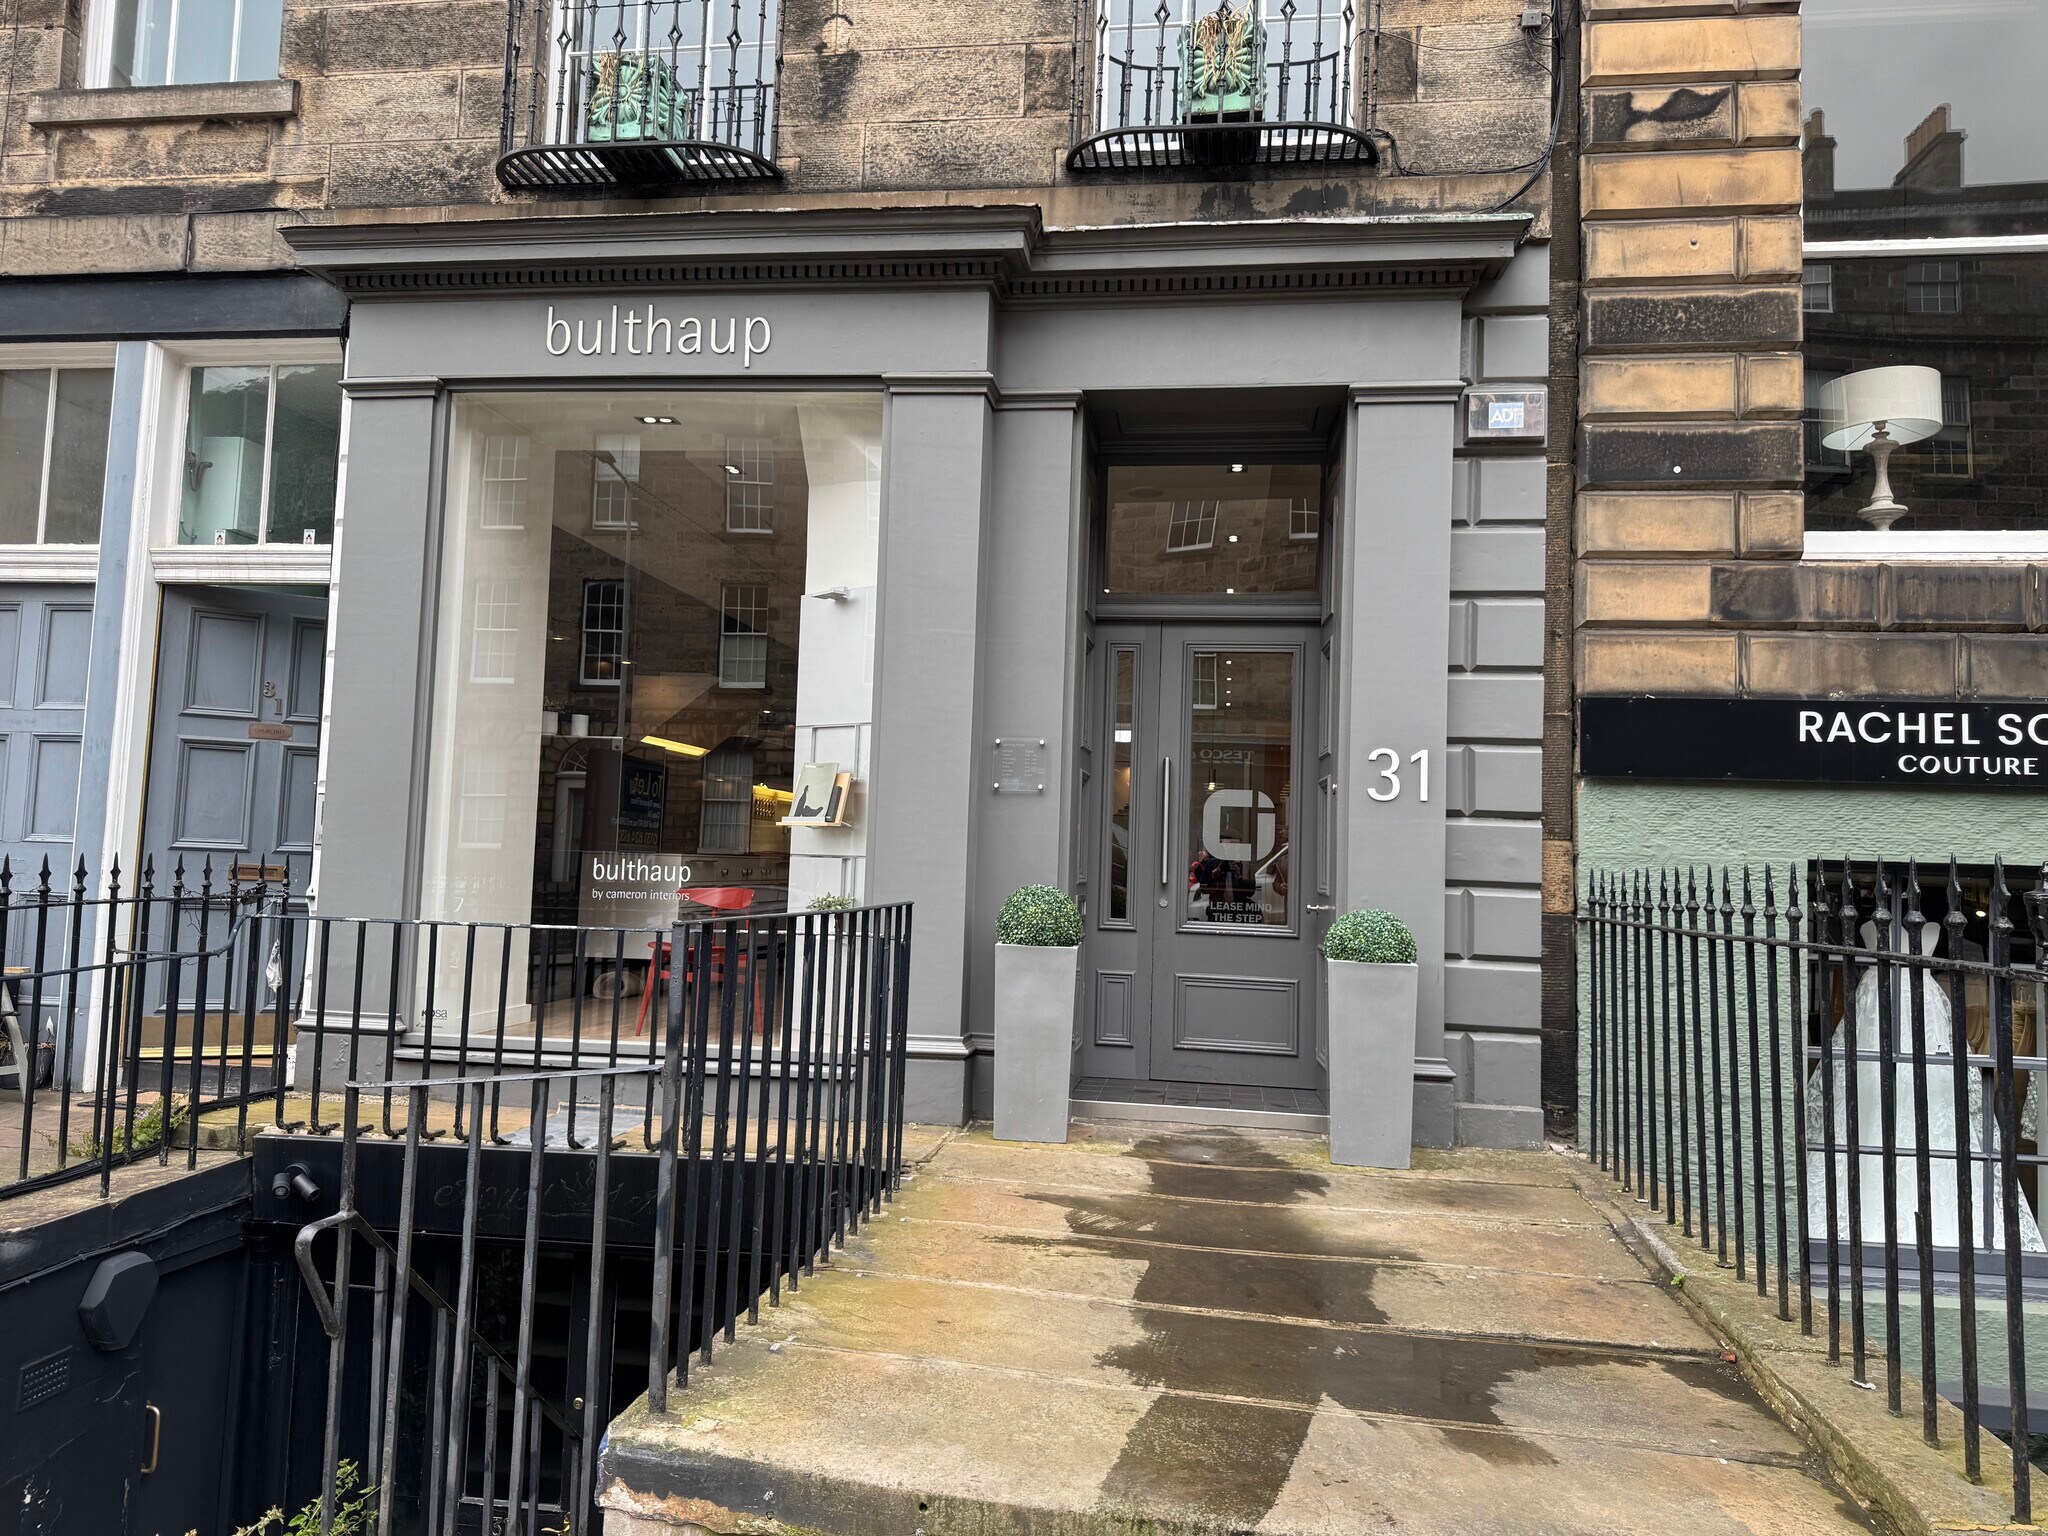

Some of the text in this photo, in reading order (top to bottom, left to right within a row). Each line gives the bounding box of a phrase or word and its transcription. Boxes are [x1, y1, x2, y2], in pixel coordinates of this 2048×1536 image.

[546, 304, 771, 368] bulthaup
[1490, 407, 1523, 423] ADT
[1799, 710, 1981, 745] RACHEL
[1367, 747, 1429, 802] 31
[1898, 754, 2040, 776] COUTURE
[593, 857, 692, 888] bulthaup
[592, 888, 690, 901] by cameron interiors
[1213, 913, 1262, 923] THE STEP
[1245, 902, 1273, 912] MIND
